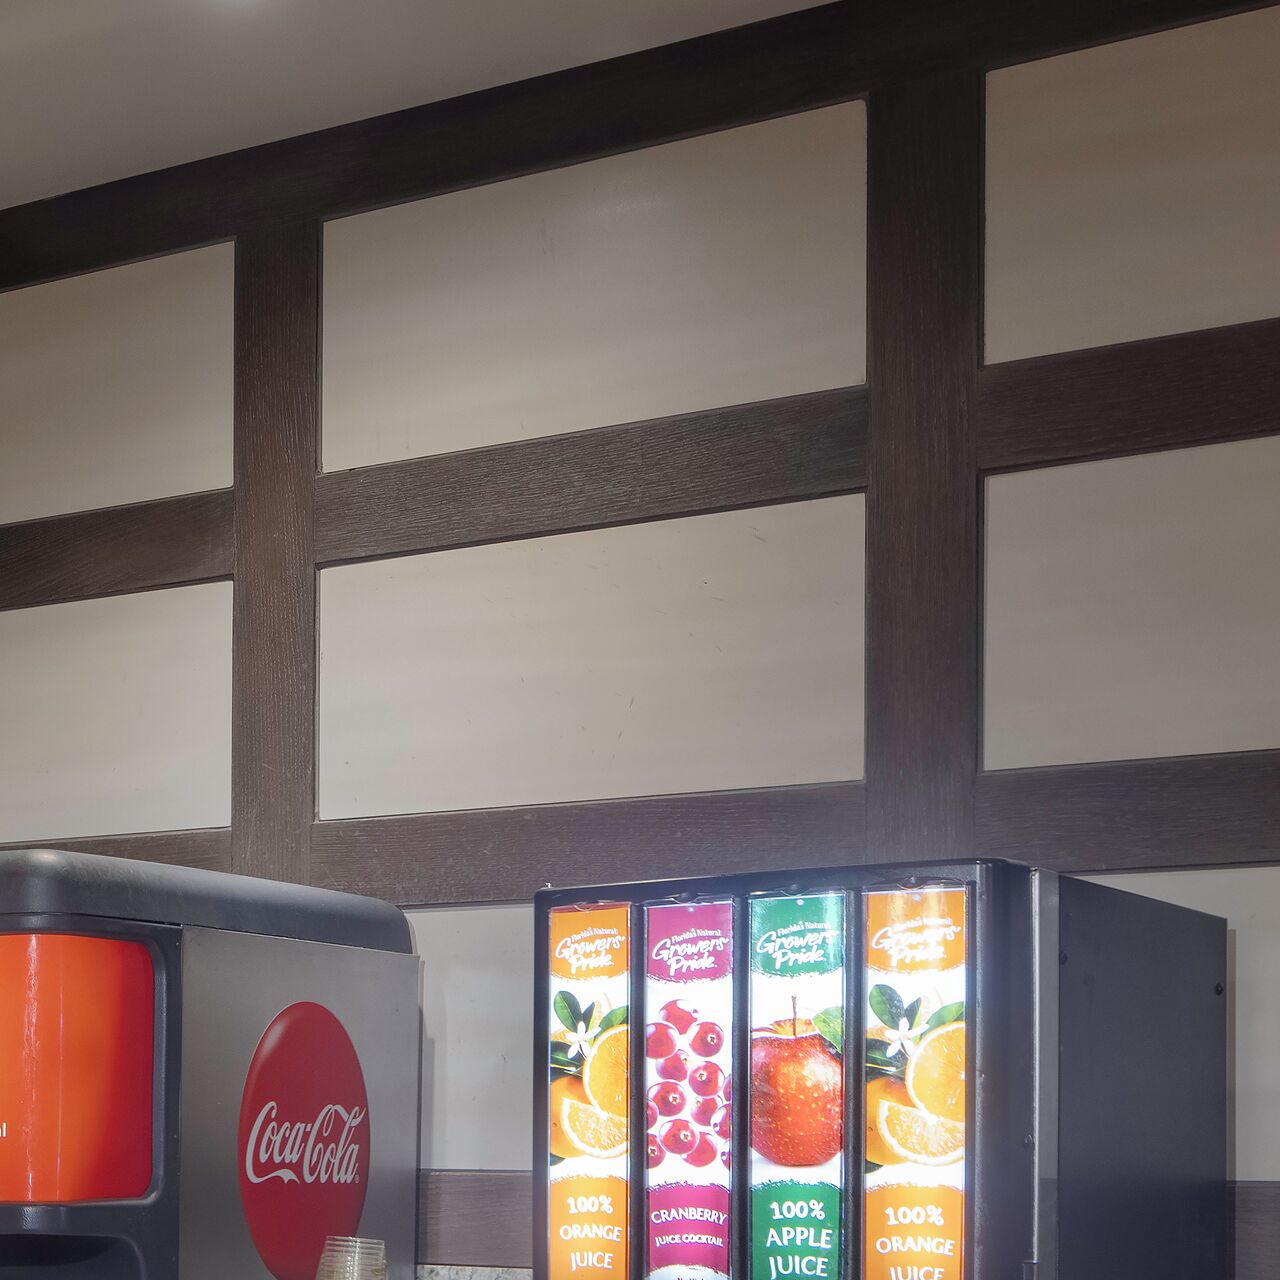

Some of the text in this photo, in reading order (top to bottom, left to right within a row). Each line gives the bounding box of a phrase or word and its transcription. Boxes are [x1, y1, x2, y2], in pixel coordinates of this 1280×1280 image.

[246, 1101, 367, 1184] Coca-Cola
[567, 1195, 613, 1214] 100%
[769, 1199, 826, 1220] 100%
[651, 1207, 728, 1225] CRANBERRY
[885, 1205, 945, 1227] 100%
[559, 1223, 622, 1242] ORANGE
[655, 1233, 724, 1247] JUICE COCKTAIL
[766, 1227, 833, 1249] APPLE
[876, 1236, 955, 1256] ORANGE
[570, 1252, 614, 1272] JUICE
[768, 1255, 828, 1280] JUICE
